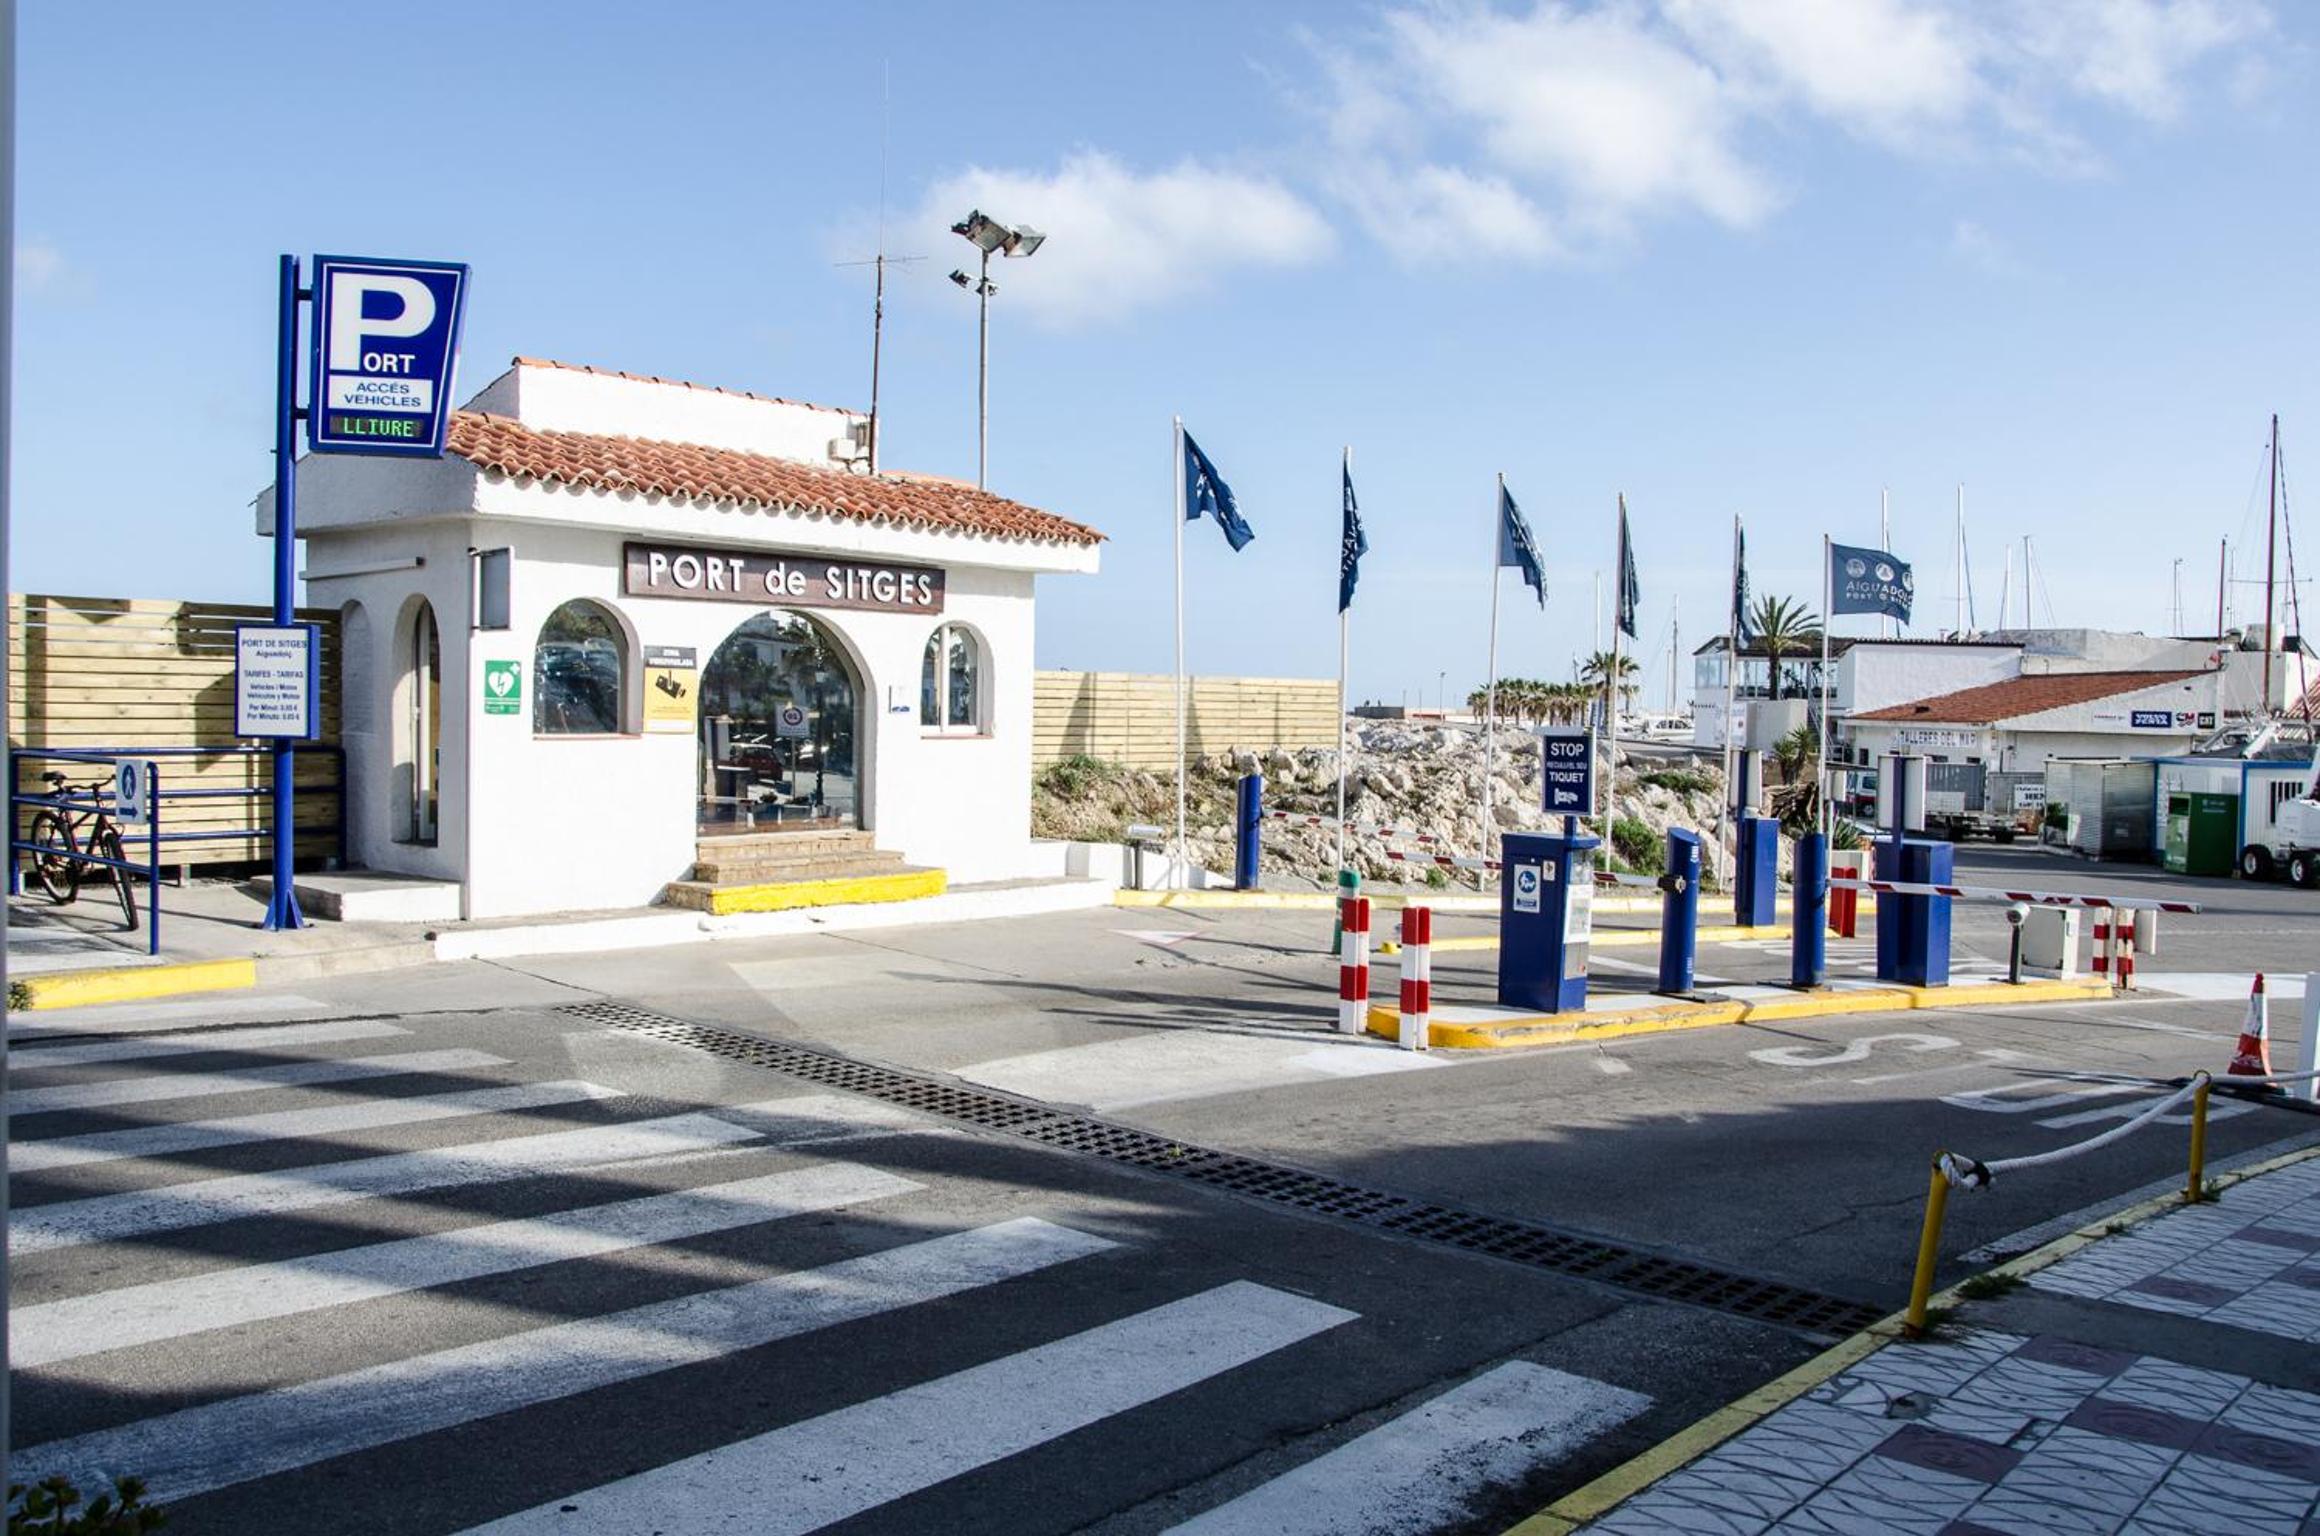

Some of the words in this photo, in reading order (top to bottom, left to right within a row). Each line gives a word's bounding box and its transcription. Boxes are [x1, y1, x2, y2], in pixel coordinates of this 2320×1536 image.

[344, 394, 421, 407] VEHICLES
[343, 417, 414, 437] LLIURE
[648, 552, 744, 592] PORT
[763, 562, 807, 596] de
[824, 566, 932, 605] SITGES
[241, 639, 262, 648] PORT
[265, 639, 276, 648] DE
[277, 639, 308, 649] SITGES
[2135, 714, 2168, 722] VOLVO
[1550, 742, 1584, 757] STOP
[1549, 771, 1584, 783] TIQUET
